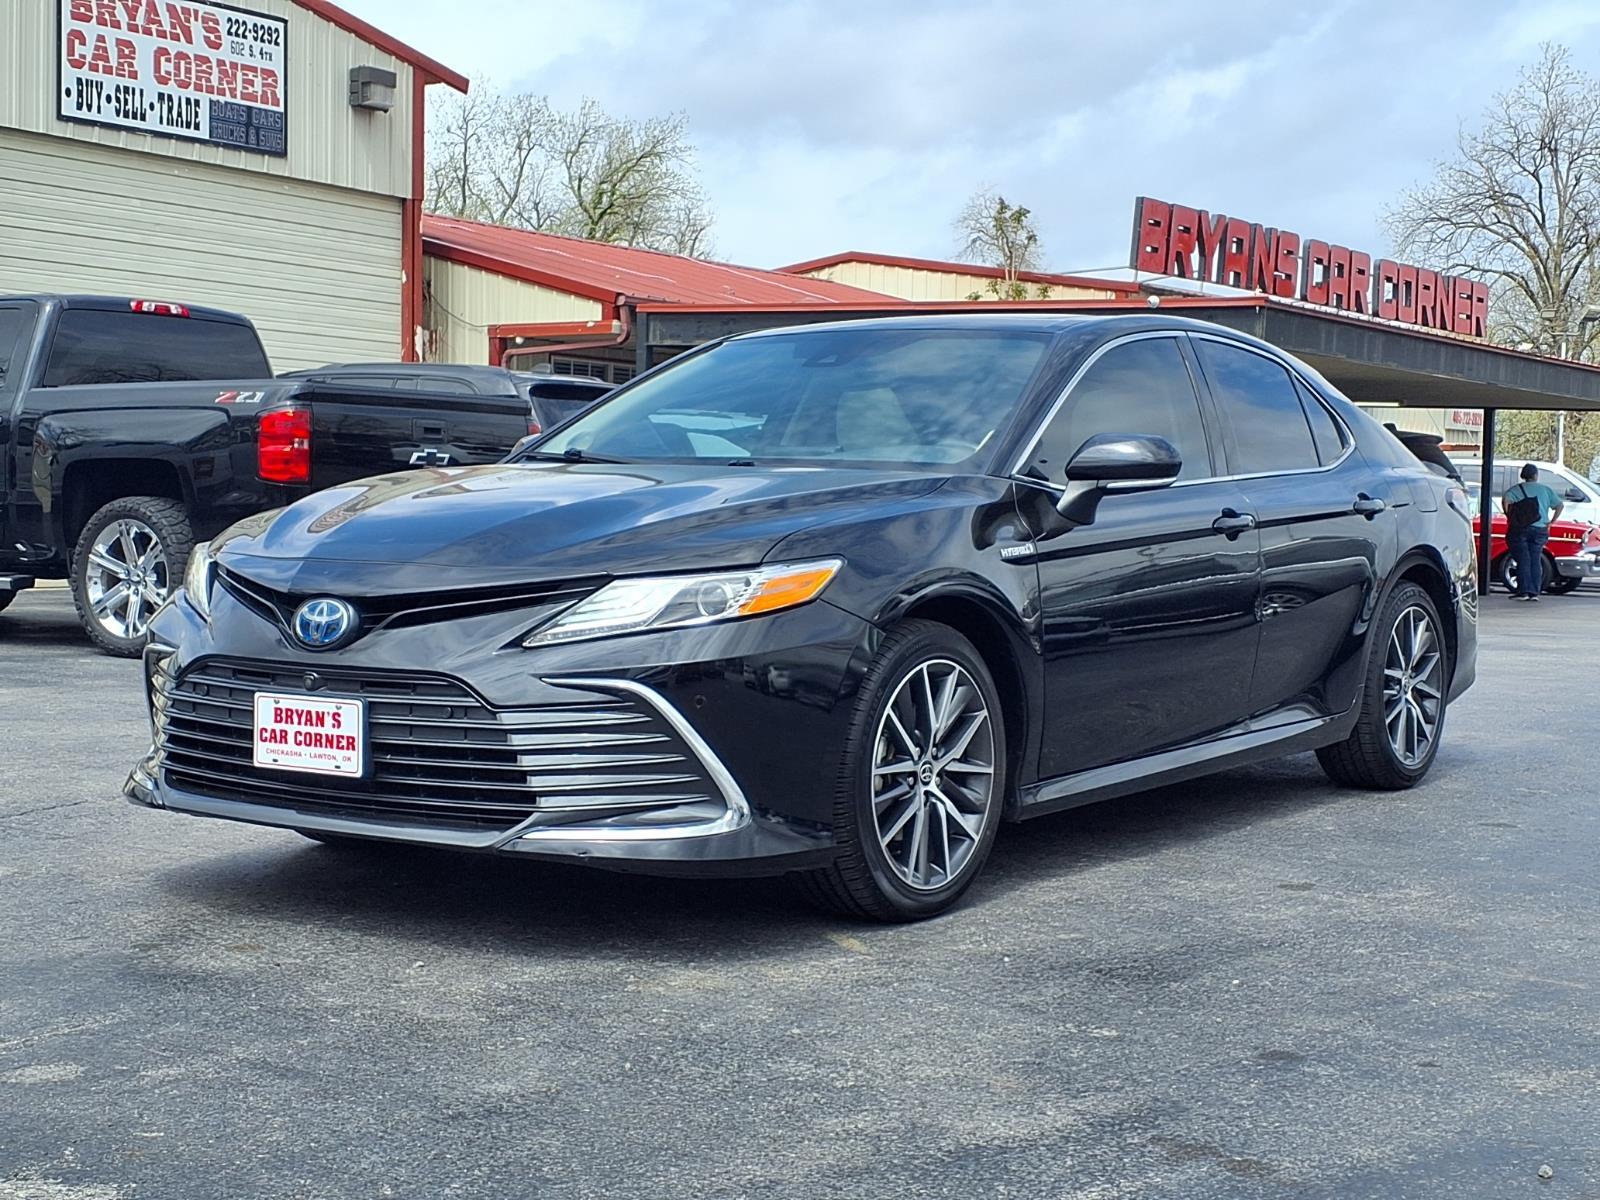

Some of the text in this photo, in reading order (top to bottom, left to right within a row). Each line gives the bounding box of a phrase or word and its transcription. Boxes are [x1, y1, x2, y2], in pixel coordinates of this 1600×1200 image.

[226, 16, 280, 47] 222-9292
[230, 40, 245, 57] 602
[66, 28, 281, 107] CAR CORNER
[76, 76, 201, 132] BUY SELL TRADE
[211, 101, 282, 128] BOATS CARS
[210, 122, 247, 143] TRUCKS
[1131, 196, 1489, 338] BRYANS CAR CORNER
[215, 391, 265, 404] Z71
[273, 706, 342, 730] BRYAN'S
[259, 727, 356, 752] CAR CORNER
[265, 747, 302, 758] CHICKASHA
